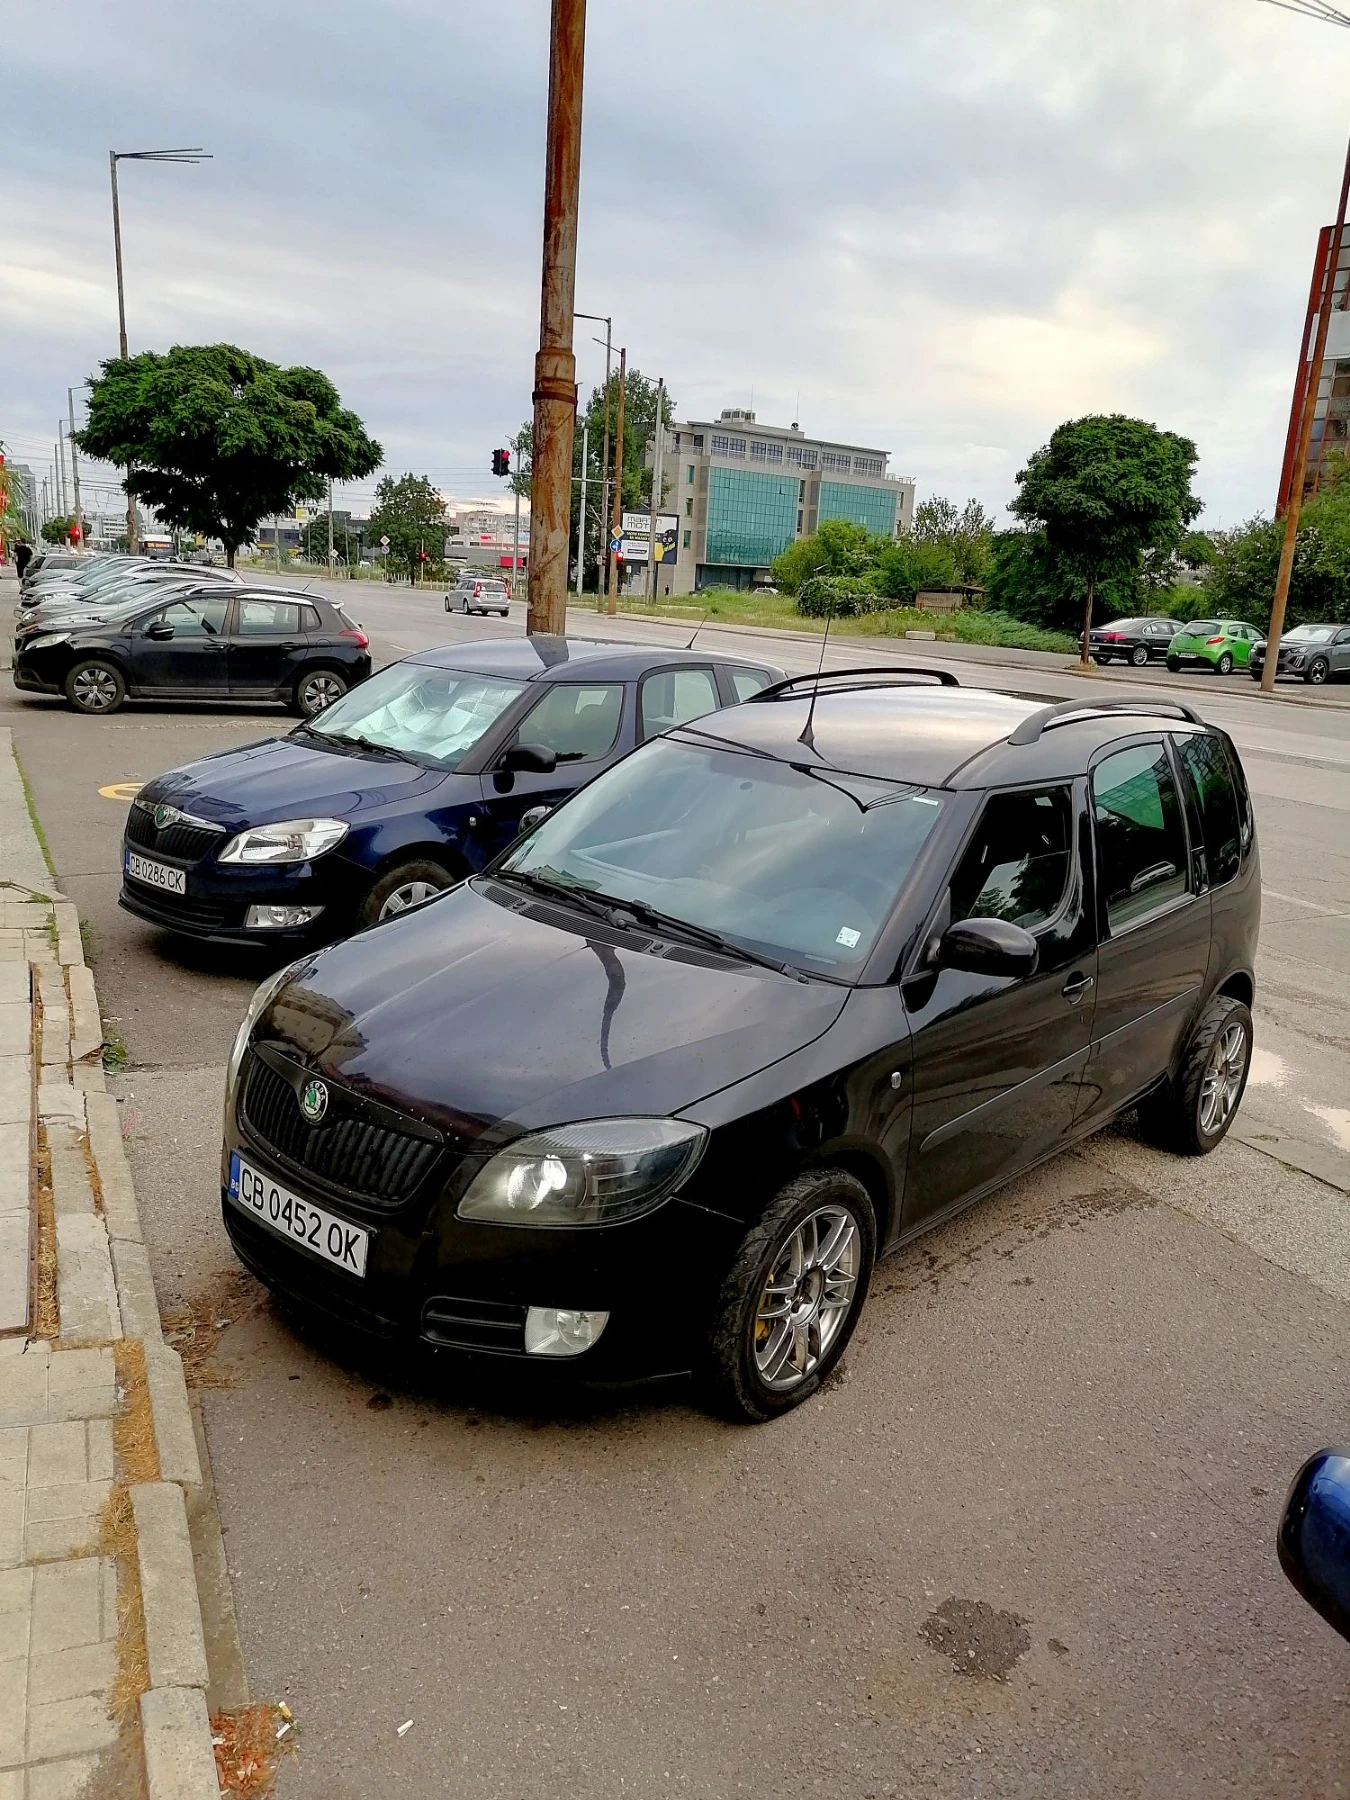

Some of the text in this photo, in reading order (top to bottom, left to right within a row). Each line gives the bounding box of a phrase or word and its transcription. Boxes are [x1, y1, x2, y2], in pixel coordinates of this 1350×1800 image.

[131, 856, 183, 891] CB 0286 CK
[242, 1168, 361, 1269] CB 0452 OK
